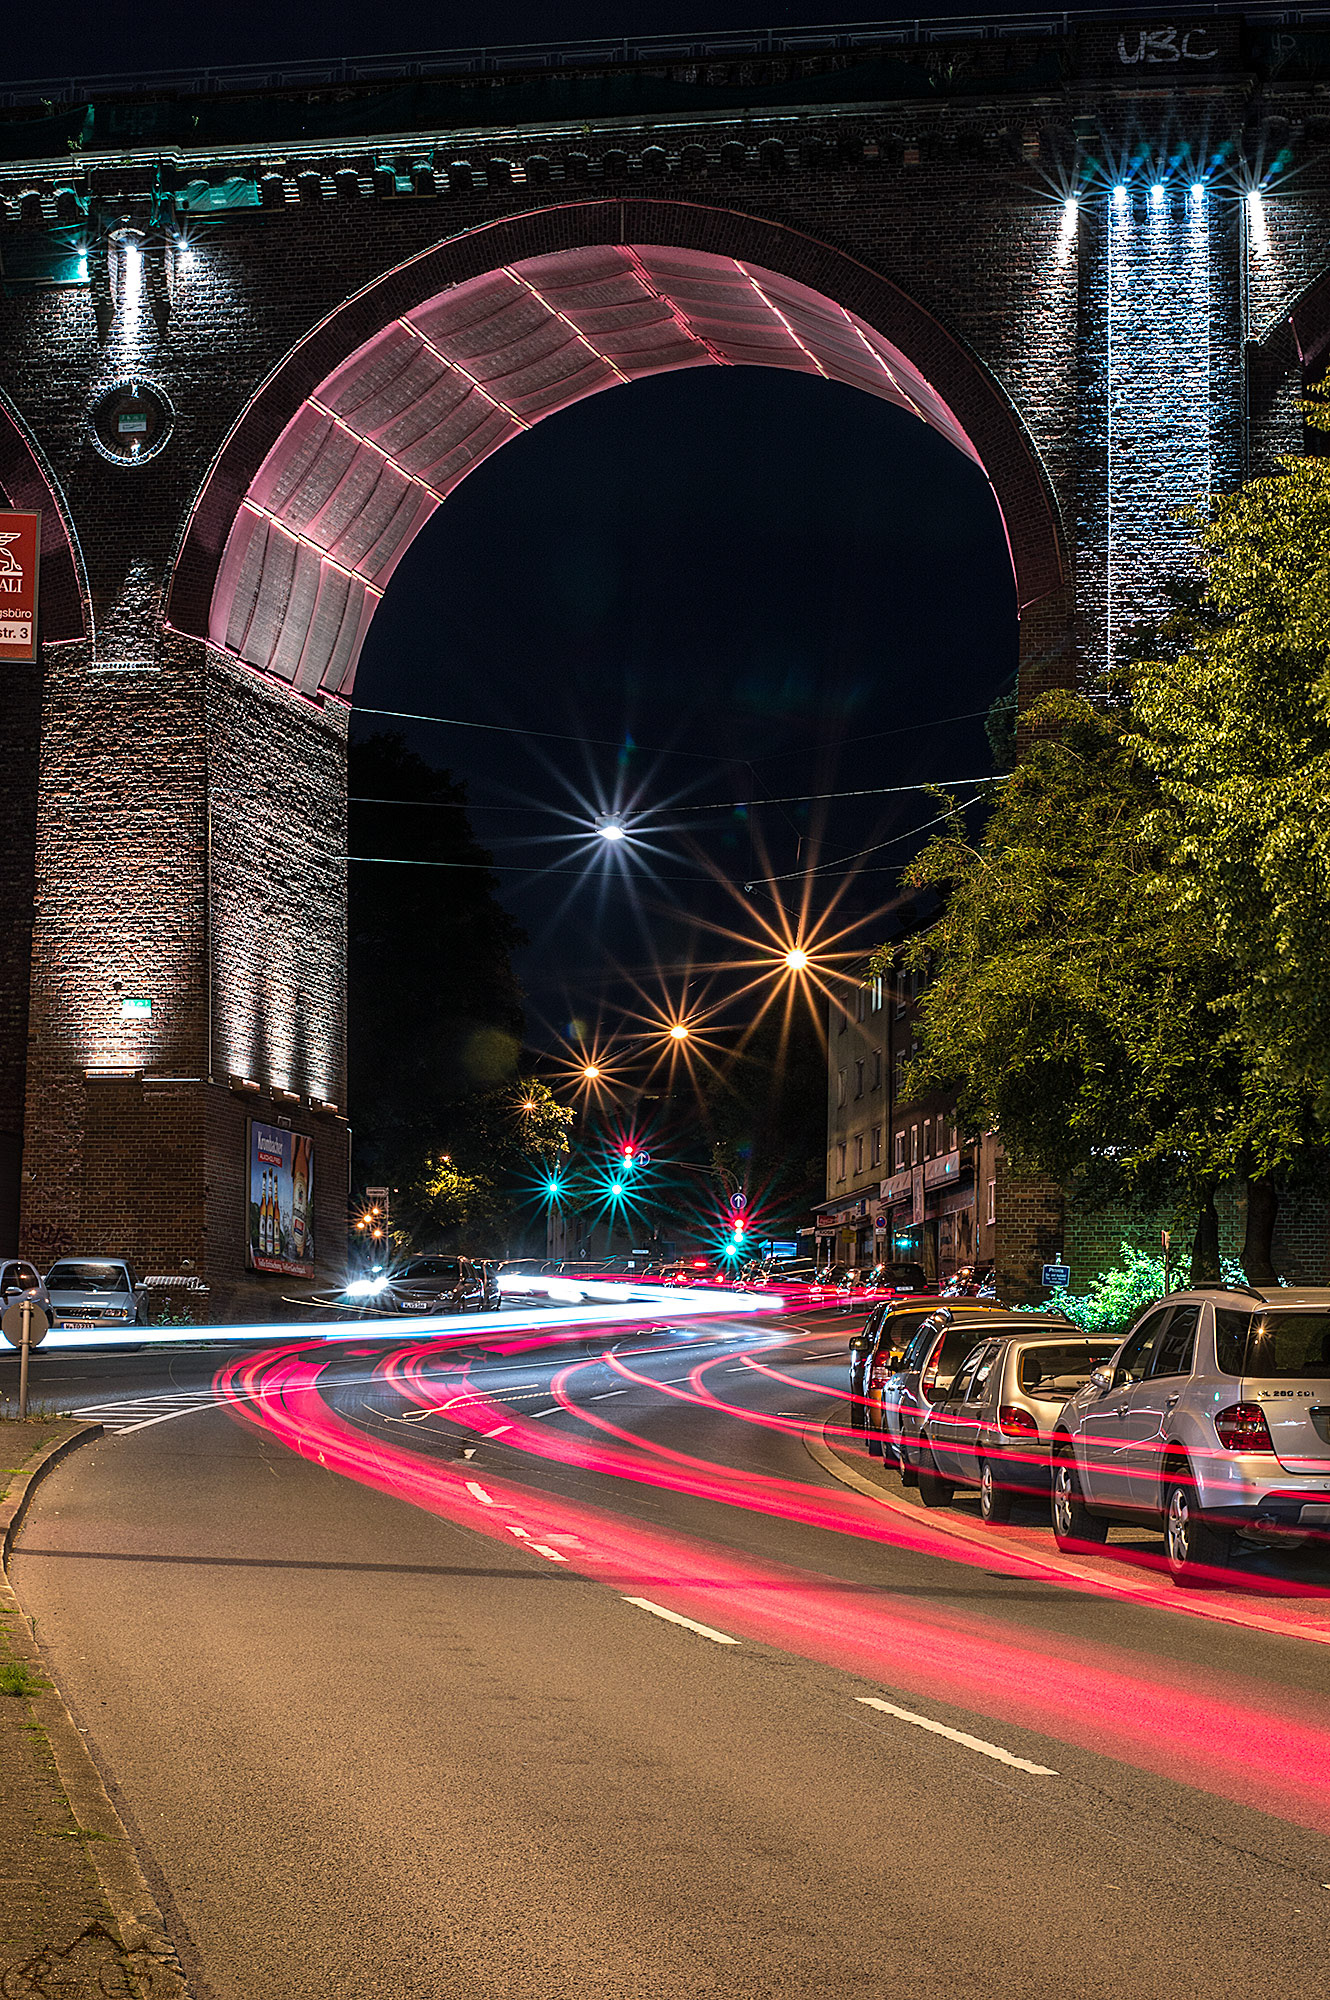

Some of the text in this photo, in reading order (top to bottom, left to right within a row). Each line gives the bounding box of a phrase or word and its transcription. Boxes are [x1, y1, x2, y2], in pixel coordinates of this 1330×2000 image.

[1117, 27, 1219, 64] UBC
[0, 578, 23, 593] ALI
[20, 627, 28, 639] 3
